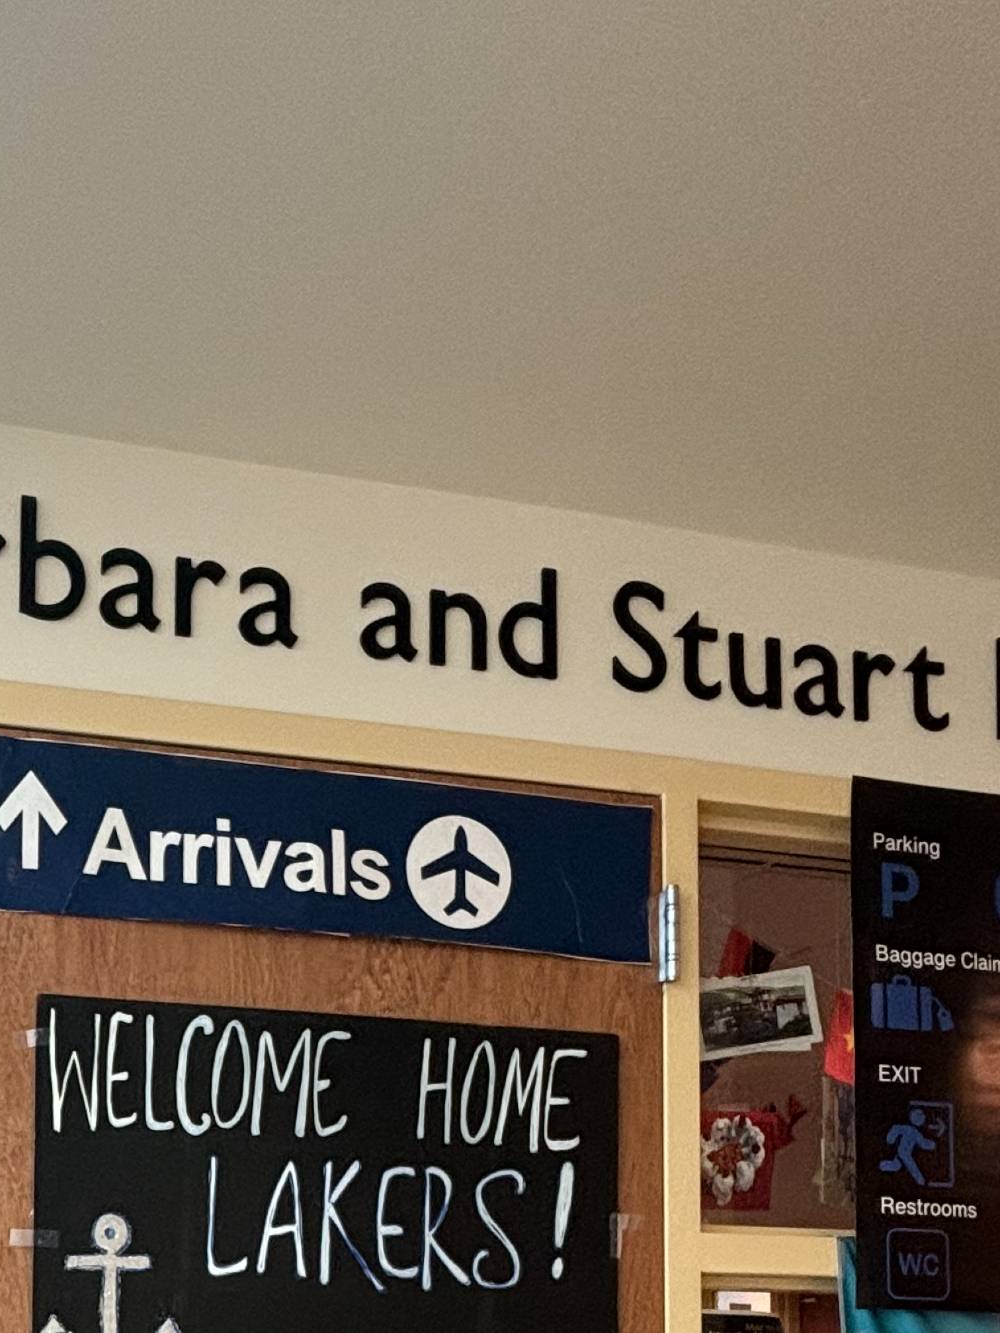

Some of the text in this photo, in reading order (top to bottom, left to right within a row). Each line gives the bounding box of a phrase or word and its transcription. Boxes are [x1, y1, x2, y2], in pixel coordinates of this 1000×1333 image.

[360, 567, 559, 681] and
[612, 579, 949, 733] Stuart
[82, 806, 391, 901] Arrivals
[873, 832, 941, 859] Parking
[875, 944, 956, 970] Baggage
[48, 1007, 588, 1154] WELCOME HOME
[879, 1064, 921, 1085] EXIT
[880, 1196, 978, 1219] Restrooms
[898, 1251, 940, 1276] WC
